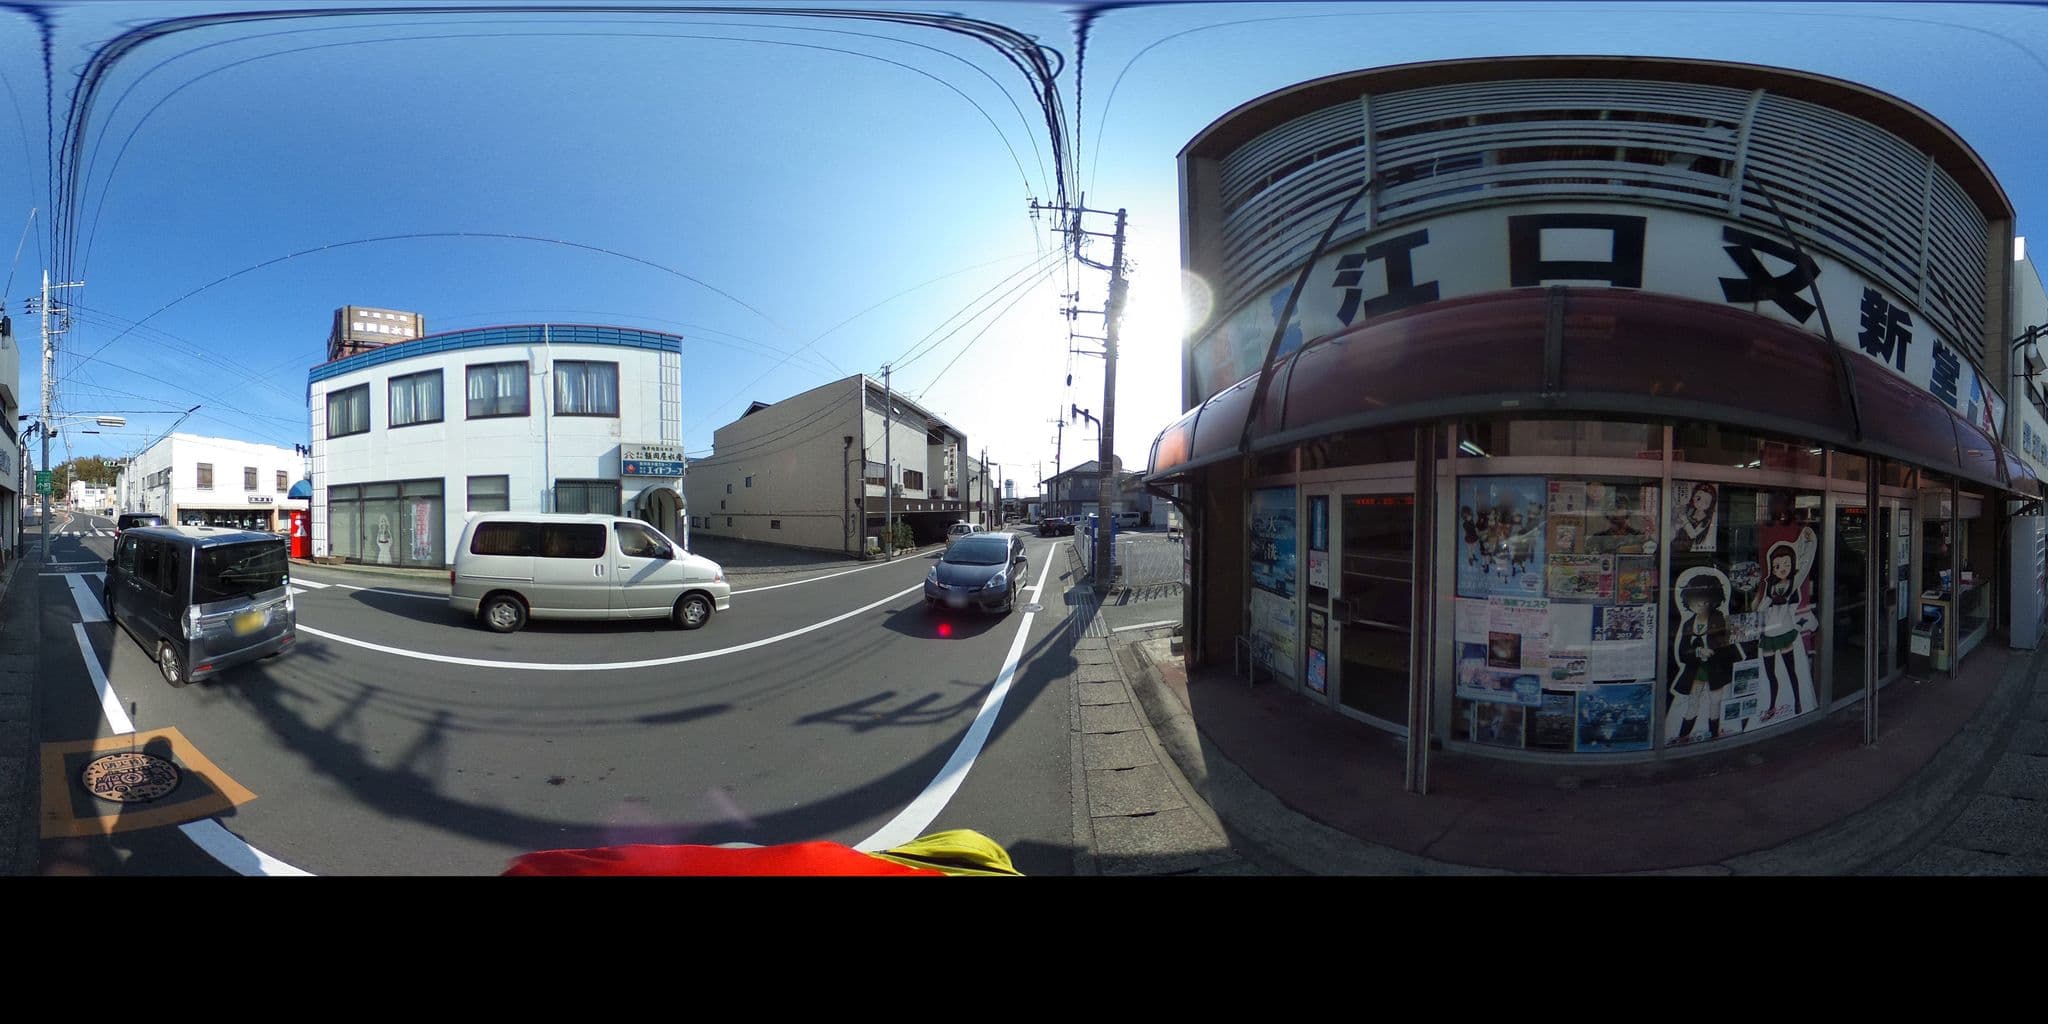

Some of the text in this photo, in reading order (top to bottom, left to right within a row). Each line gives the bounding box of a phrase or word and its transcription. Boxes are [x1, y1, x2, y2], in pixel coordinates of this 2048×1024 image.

[1334, 213, 1961, 408] 江口又新堂
